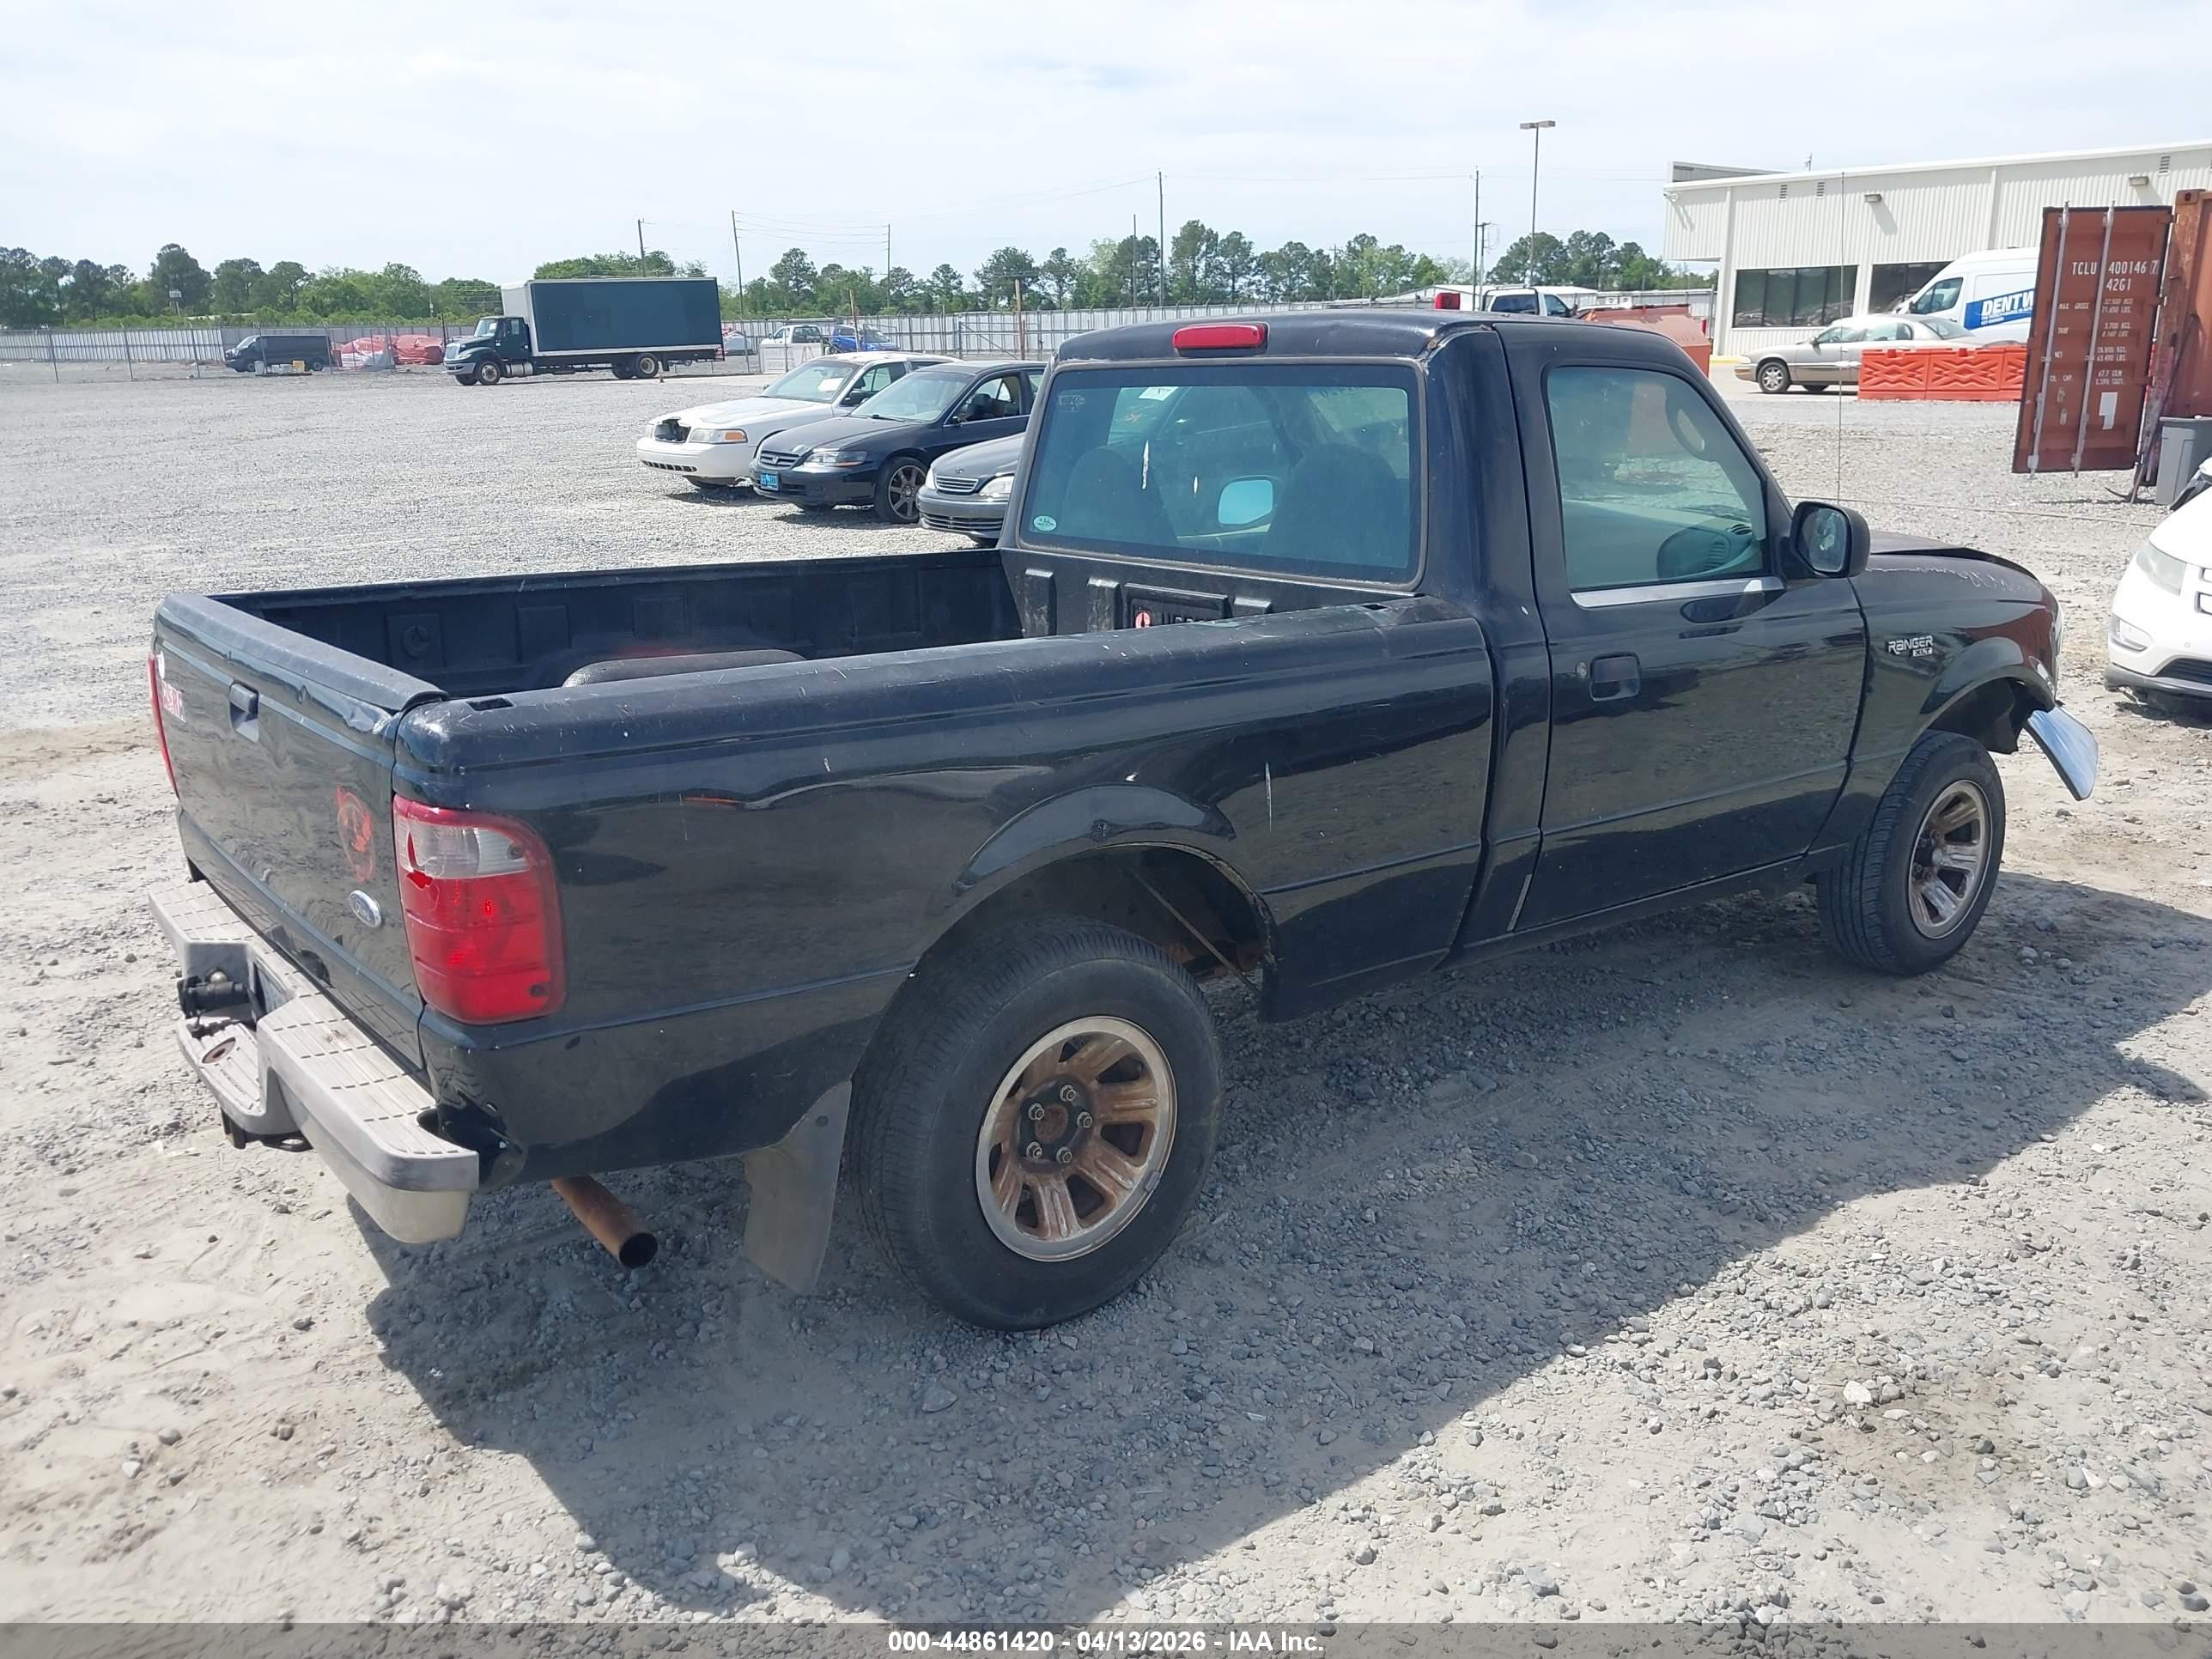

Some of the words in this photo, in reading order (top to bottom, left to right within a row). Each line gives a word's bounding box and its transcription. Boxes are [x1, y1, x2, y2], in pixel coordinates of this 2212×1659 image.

[2071, 261, 2099, 276] TCLU
[2108, 260, 2148, 275] 400146
[2150, 260, 2159, 274] 7
[2106, 277, 2132, 292] 42G1
[1887, 635, 1933, 654] RANGER
[1914, 647, 1932, 656] XLT
